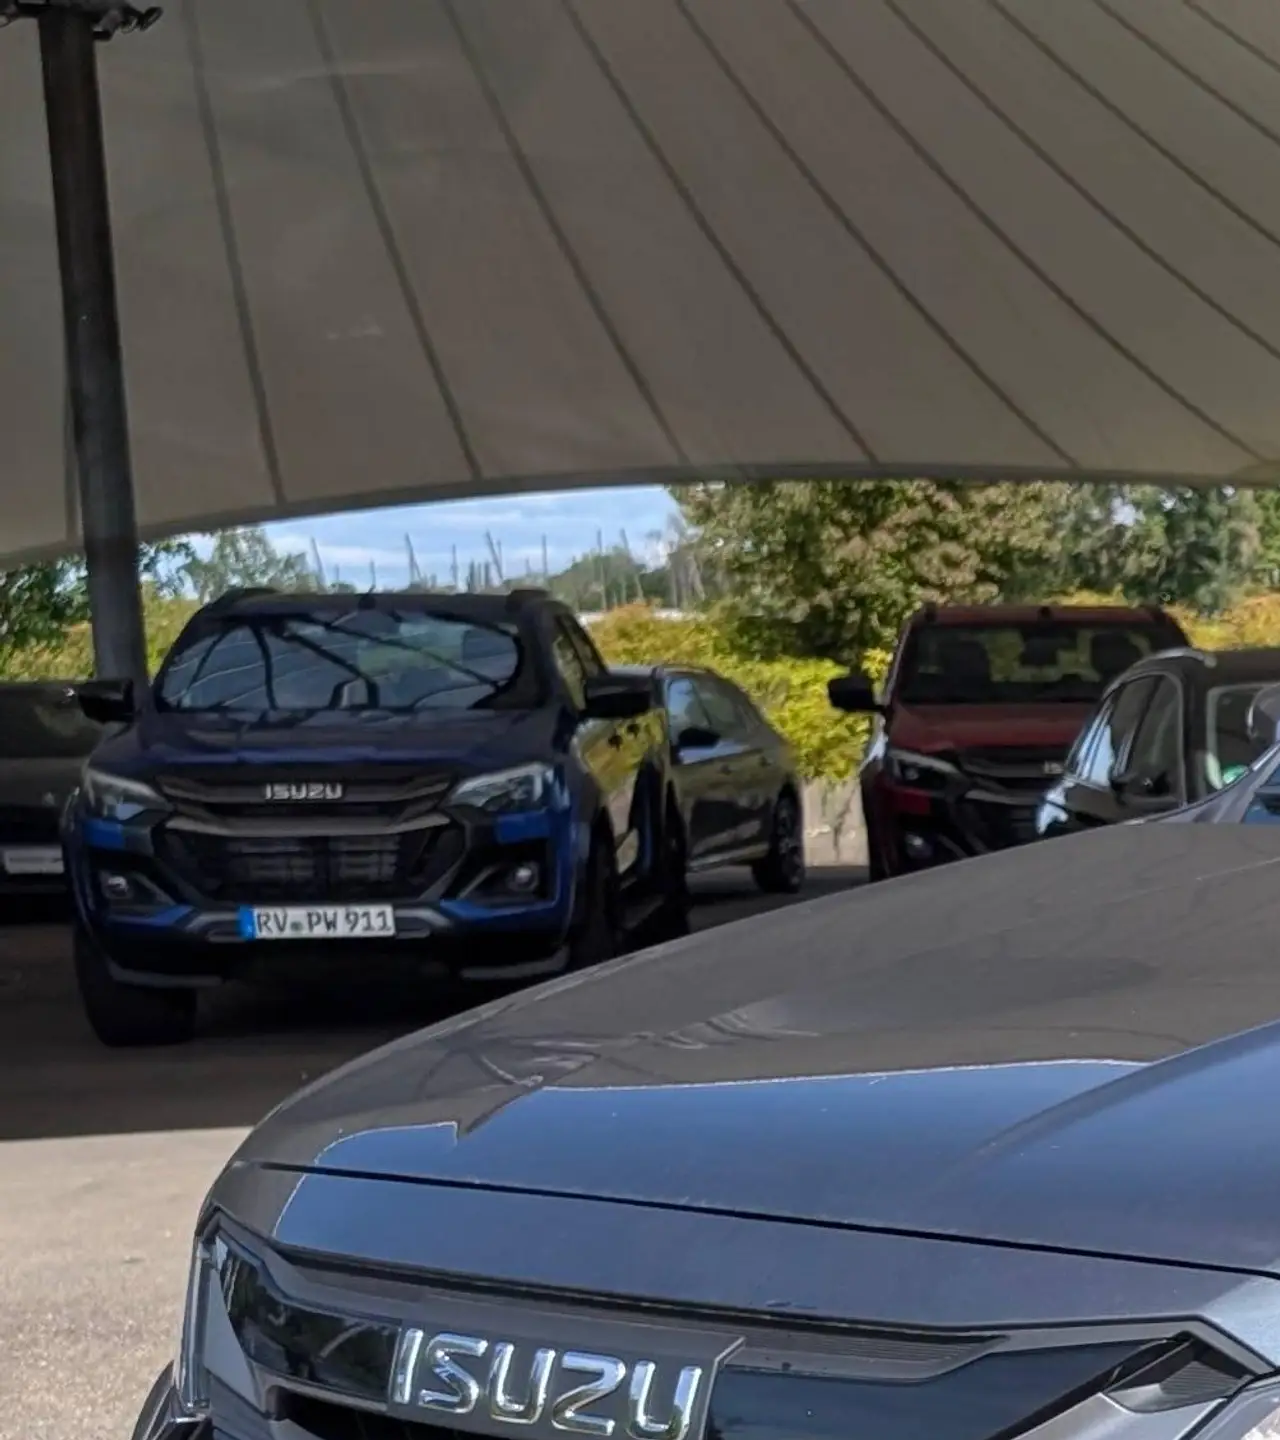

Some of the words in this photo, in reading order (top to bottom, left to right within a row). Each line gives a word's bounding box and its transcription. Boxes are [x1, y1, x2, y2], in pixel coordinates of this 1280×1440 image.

[264, 783, 342, 800] ISUZU
[256, 908, 288, 933] RV
[306, 911, 337, 931] PW
[345, 909, 392, 932] 911
